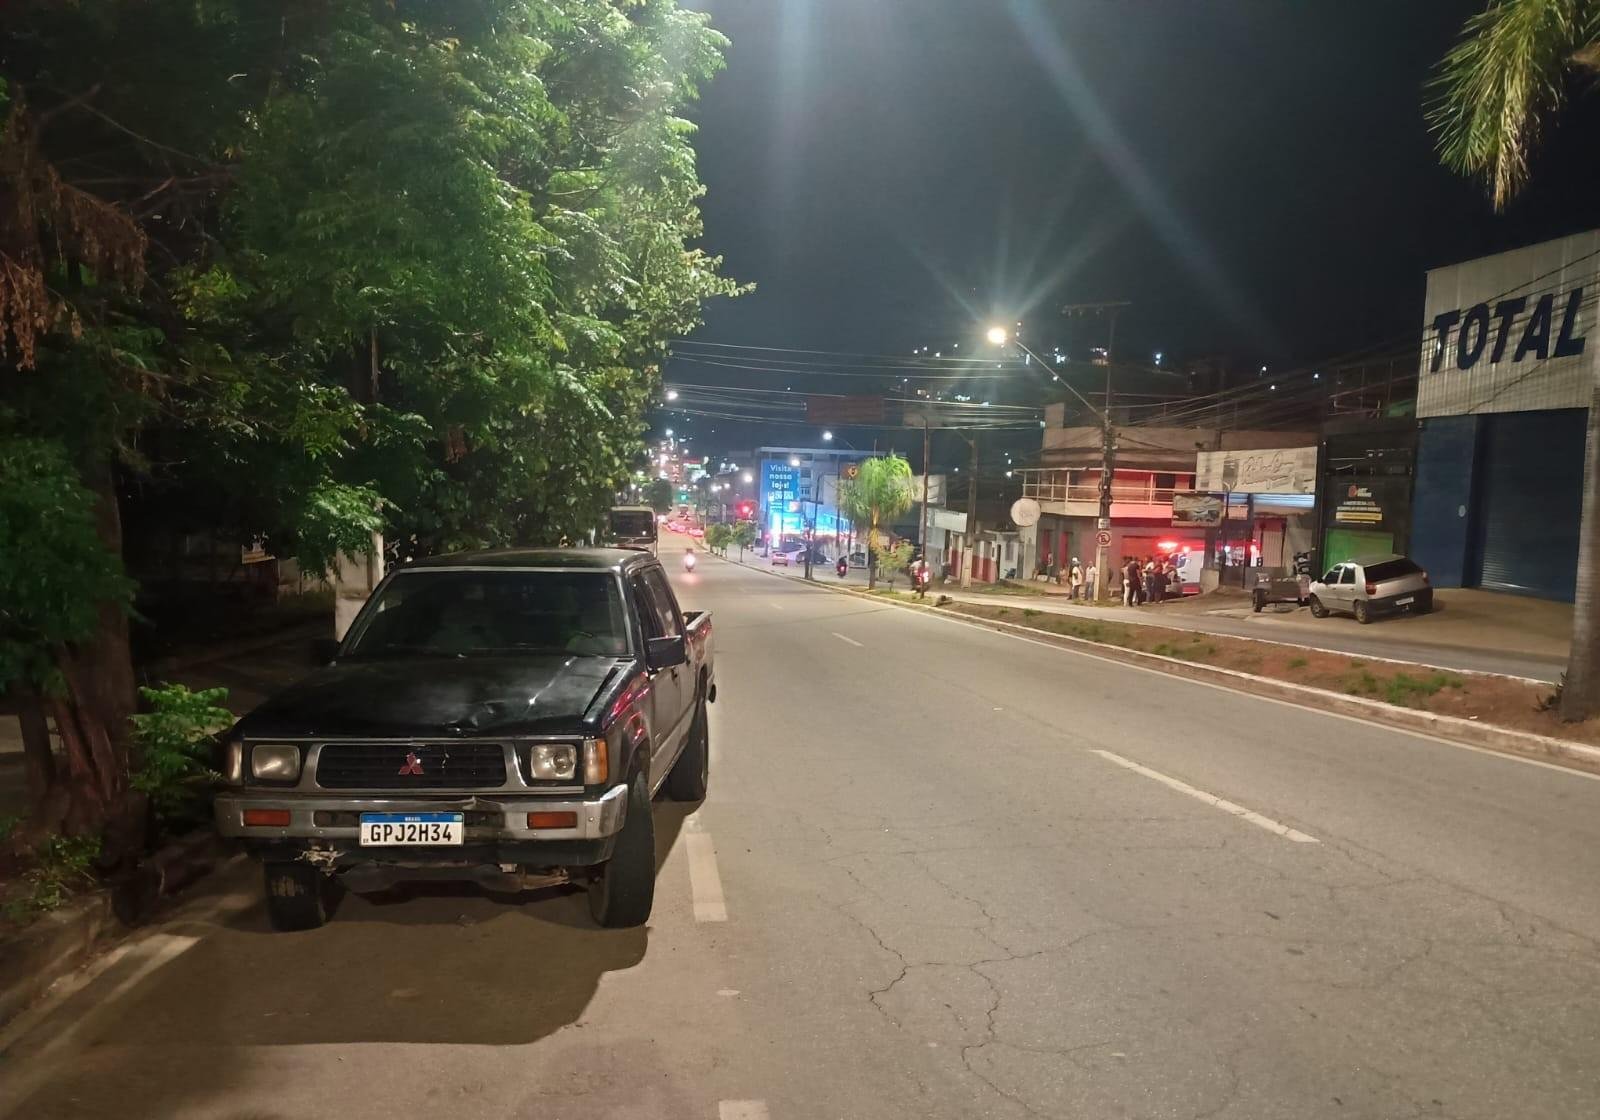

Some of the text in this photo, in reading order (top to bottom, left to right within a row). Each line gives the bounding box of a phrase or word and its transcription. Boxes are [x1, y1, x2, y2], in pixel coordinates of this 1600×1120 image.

[1430, 287, 1586, 373] TOTAL
[769, 464, 792, 472] Visita
[370, 823, 453, 842] GPJ2H34
